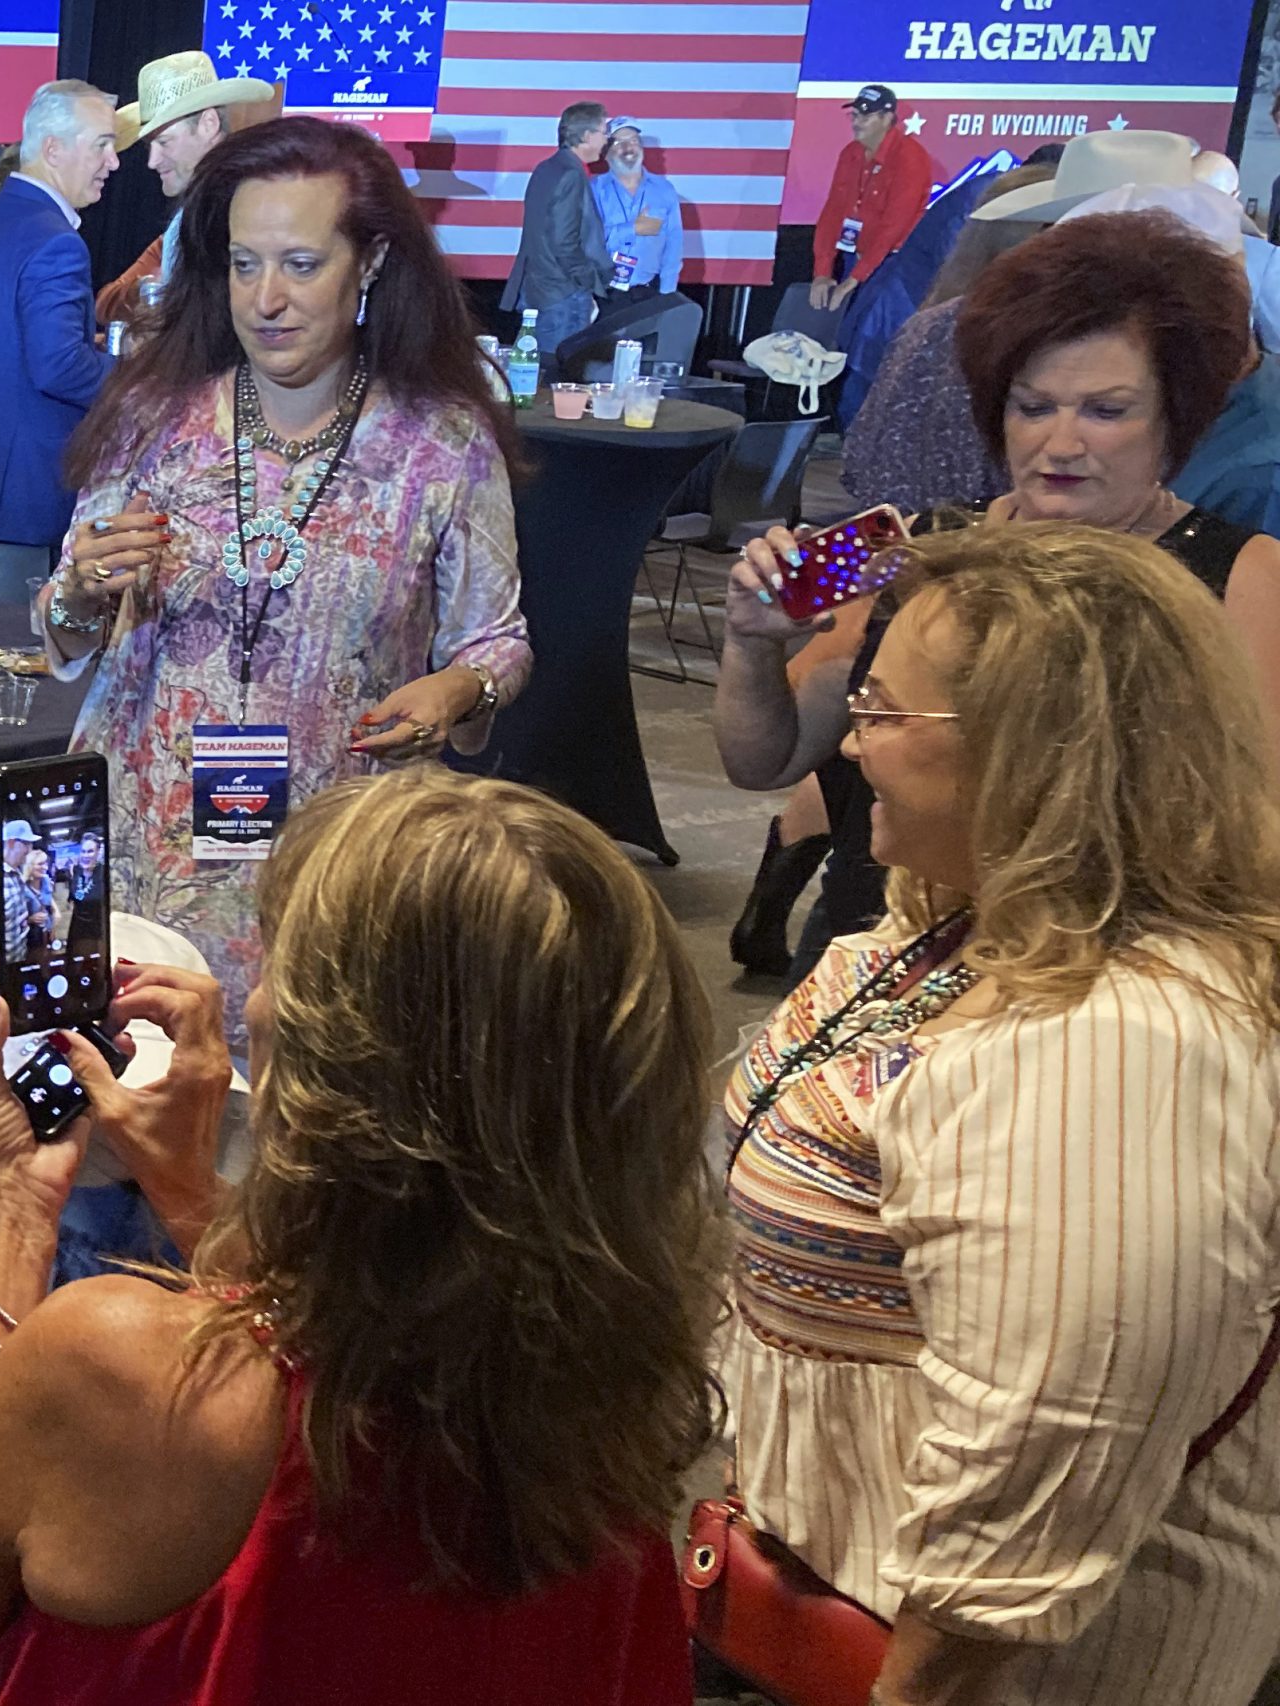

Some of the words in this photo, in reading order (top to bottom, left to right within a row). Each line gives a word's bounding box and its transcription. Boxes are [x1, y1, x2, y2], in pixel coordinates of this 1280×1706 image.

[905, 22, 1156, 62] HAGEMAN
[945, 114, 985, 135] FOR
[991, 114, 1089, 136] WYOMING
[195, 743, 226, 751] TEAM
[228, 743, 287, 751] HAGEMAN
